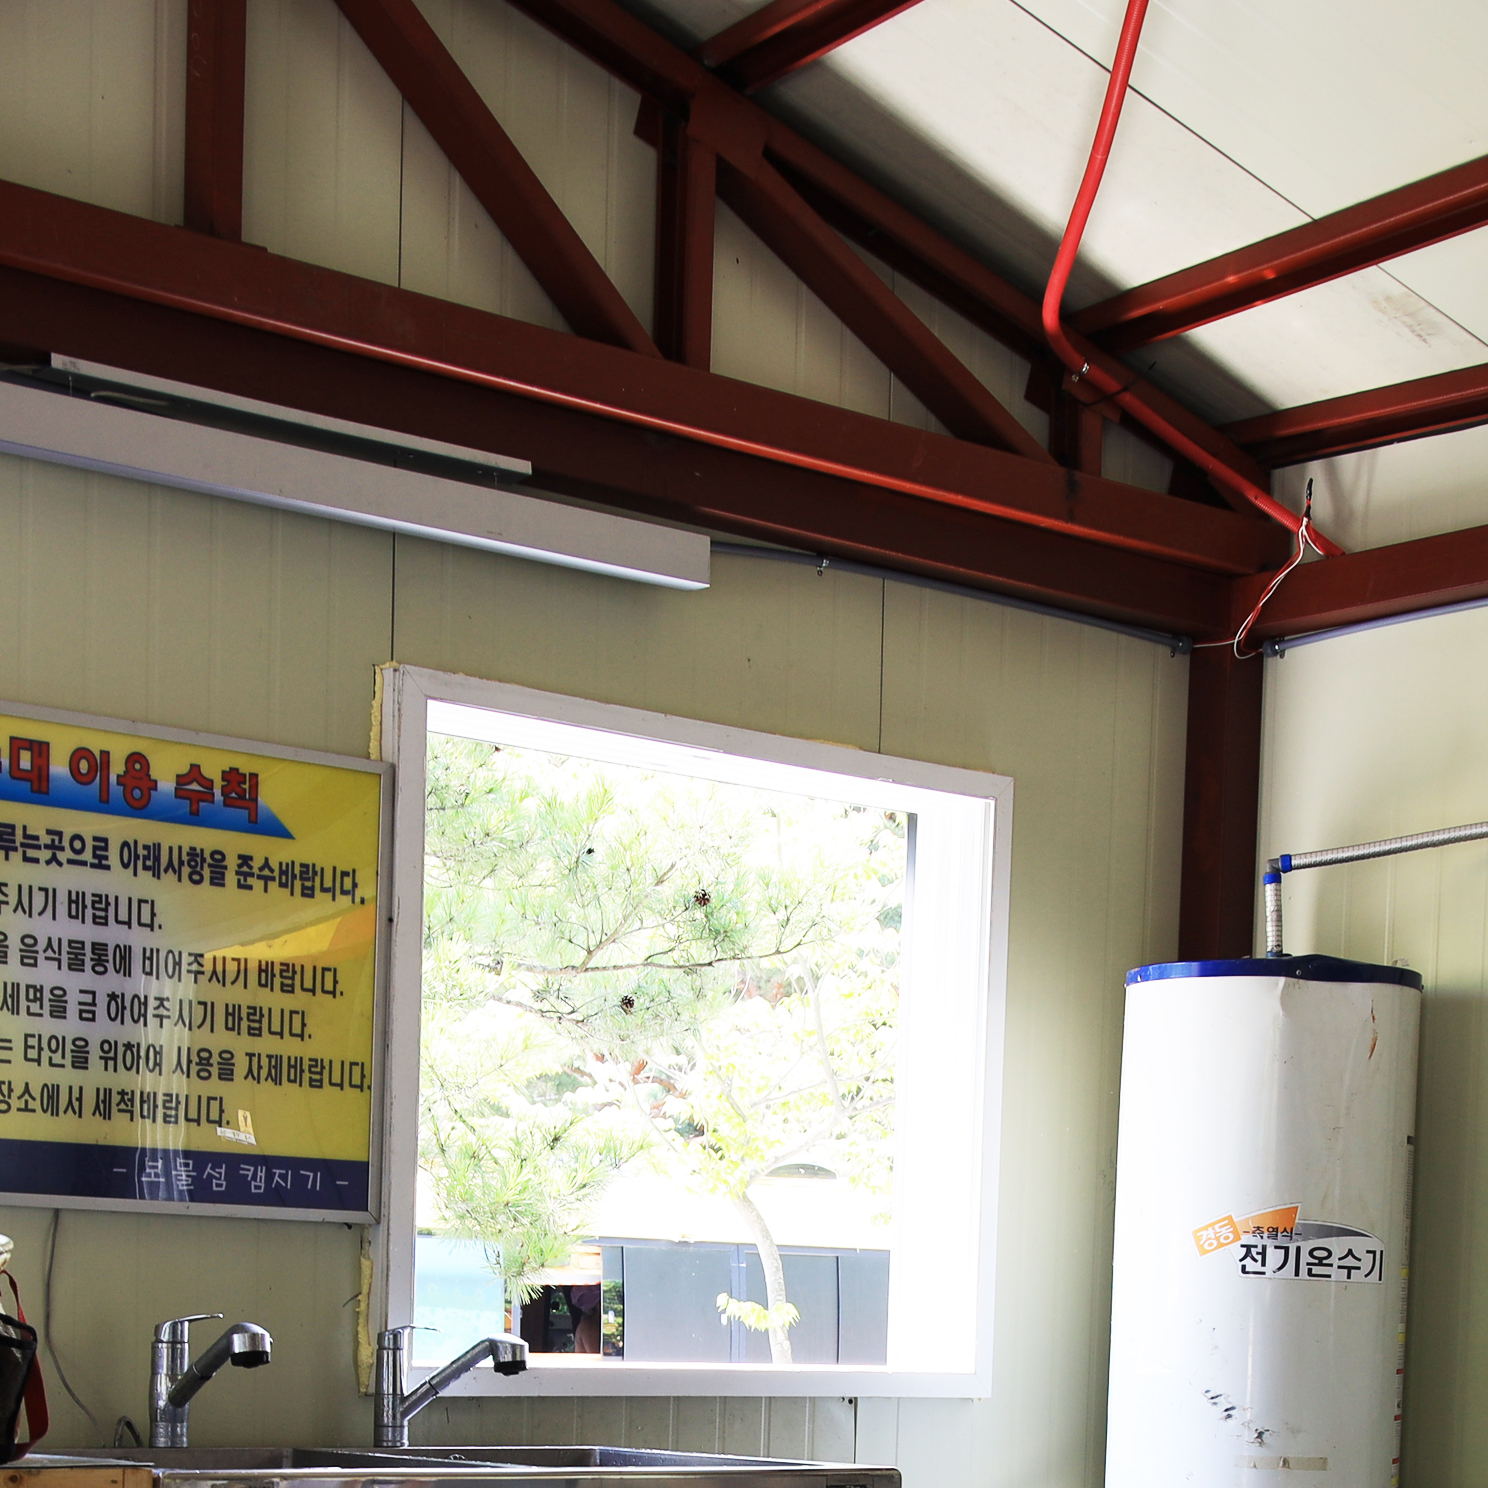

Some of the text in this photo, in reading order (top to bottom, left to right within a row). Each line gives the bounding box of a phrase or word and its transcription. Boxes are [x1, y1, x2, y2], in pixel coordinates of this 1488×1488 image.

[69, 746, 158, 810] 이용
[174, 763, 259, 825] 수칙
[119, 839, 228, 888] 아래사항을
[234, 853, 366, 905] 준수바랍니다.
[67, 888, 162, 932] 바랍니다.
[18, 933, 132, 978] 음식물통에
[142, 946, 249, 989] 비어주시기
[257, 960, 344, 999] 바랍니다.
[0, 980, 68, 1020] 세면을
[77, 988, 97, 1023] 금
[106, 991, 215, 1034] 하여주시기
[224, 1001, 312, 1042] 바랍니다.
[23, 1032, 89, 1071] 타인을
[99, 1036, 163, 1077] 위하여
[172, 1045, 235, 1082] 사용을
[244, 1050, 372, 1093] 자제바랍니다.
[92, 1086, 230, 1127] 세척바랍니다.
[141, 1156, 321, 1193] 보물섬 캠지기
[1197, 1218, 1234, 1252] 경동
[1239, 1243, 1384, 1281] 전기온수기
